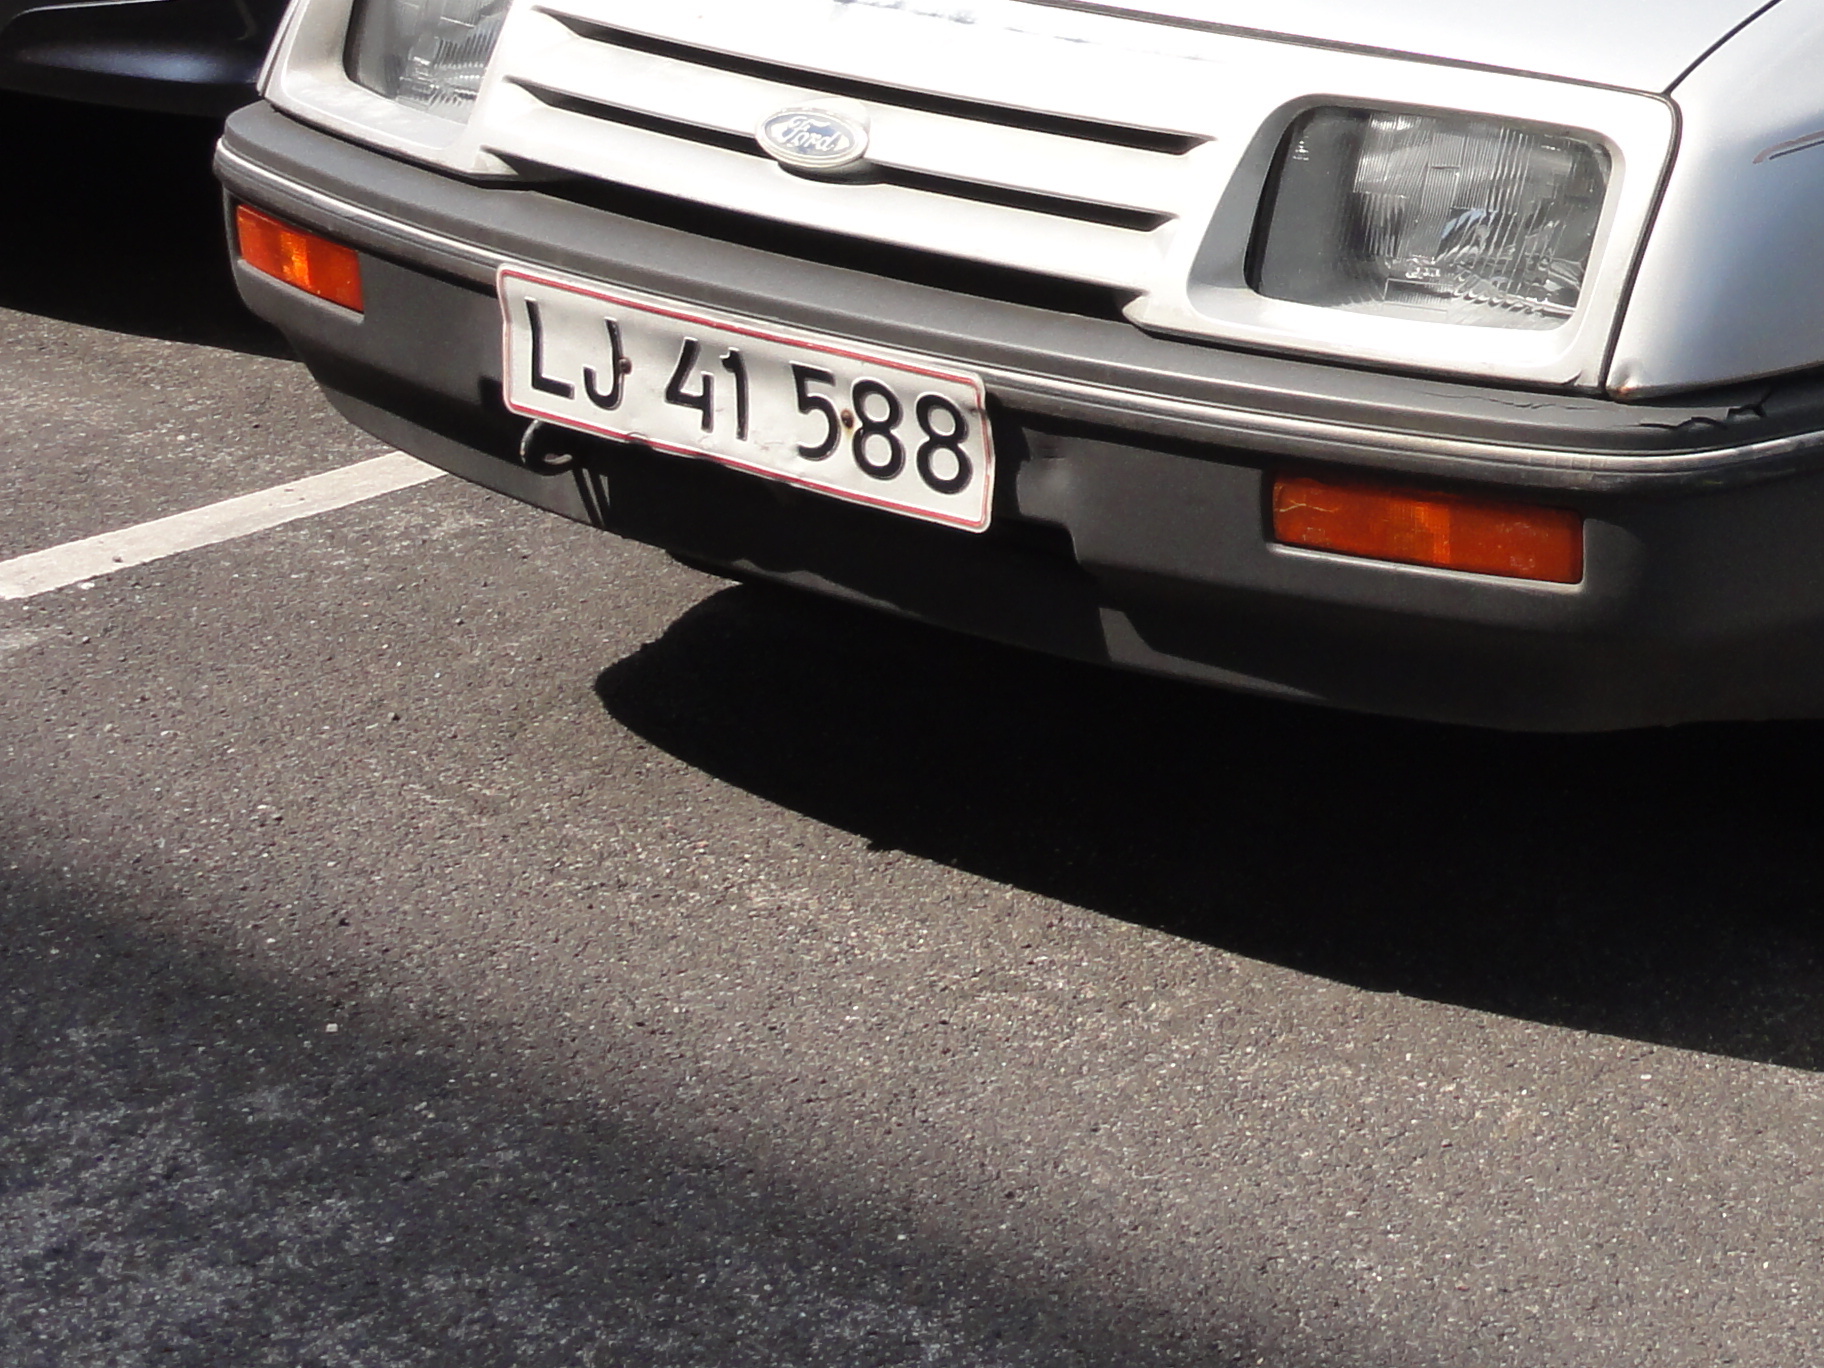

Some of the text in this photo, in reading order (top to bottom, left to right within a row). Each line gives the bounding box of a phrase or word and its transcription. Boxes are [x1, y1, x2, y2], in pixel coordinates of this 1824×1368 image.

[774, 116, 838, 152] Ford
[523, 296, 973, 495] LJ 41 588
